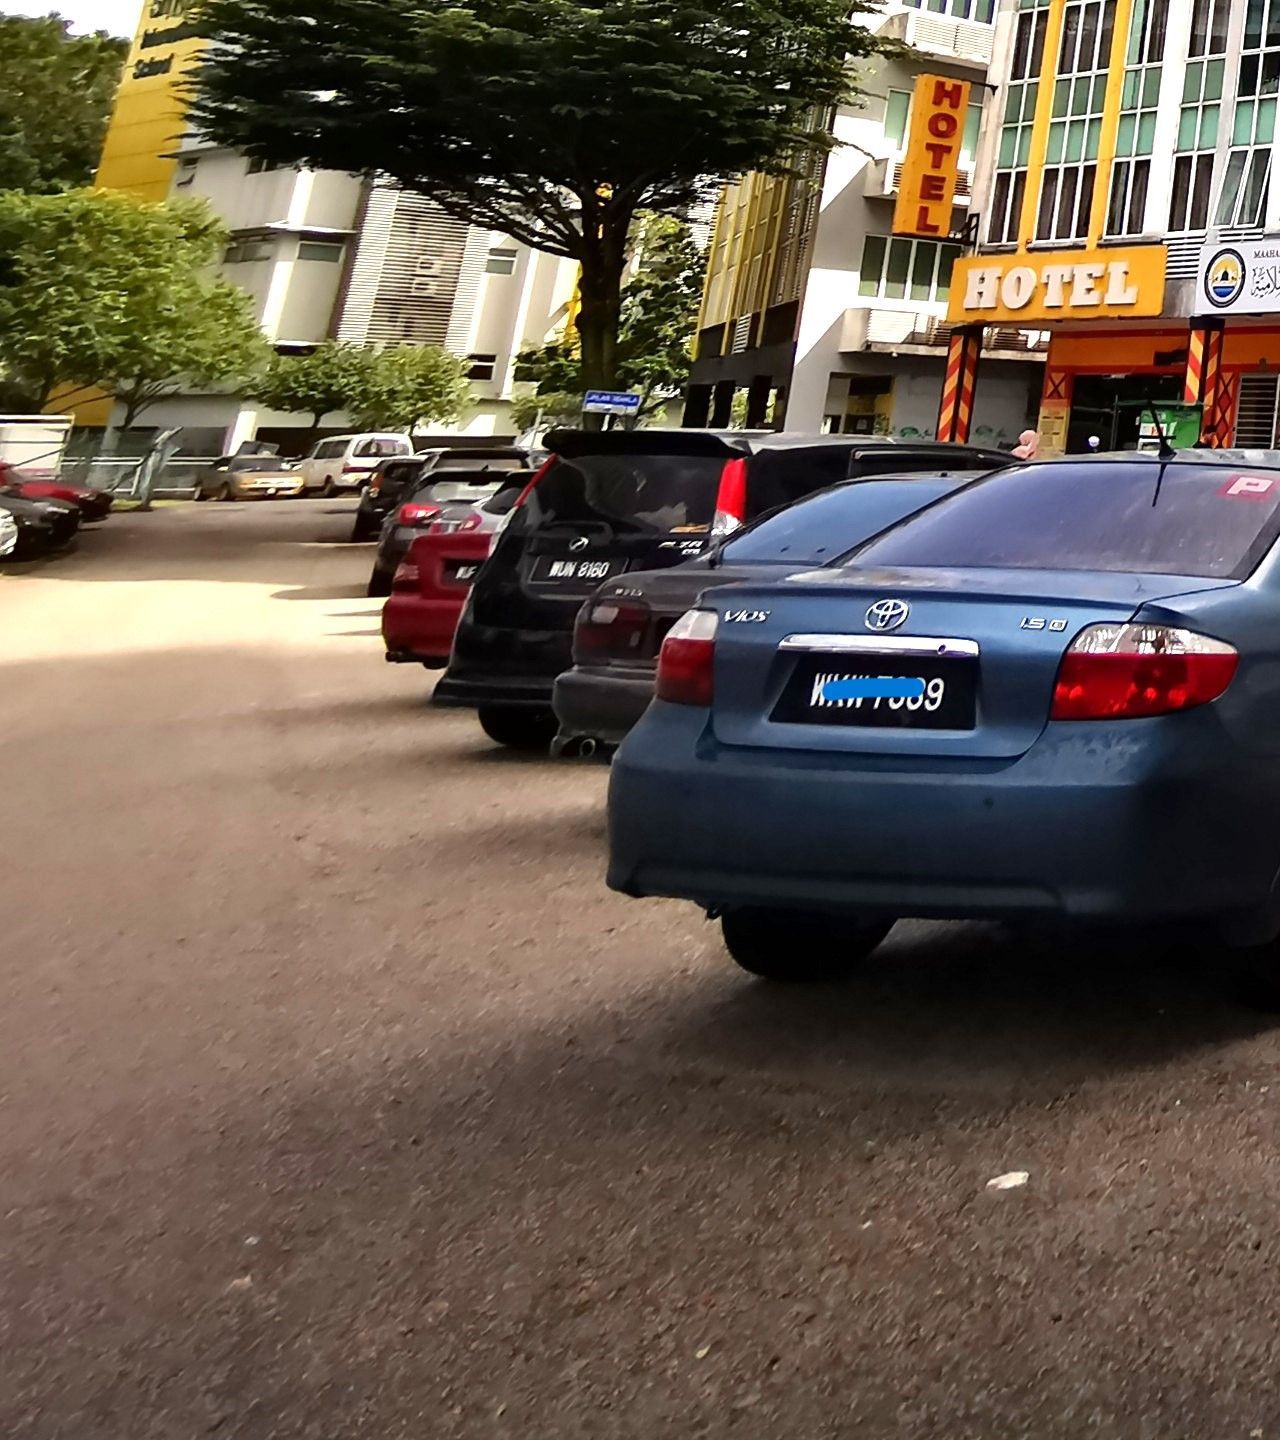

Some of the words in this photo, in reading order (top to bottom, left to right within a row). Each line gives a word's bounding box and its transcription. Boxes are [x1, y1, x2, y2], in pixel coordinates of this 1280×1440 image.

[916, 80, 962, 233] HOTEL
[963, 261, 1138, 310] HOTEL
[1227, 477, 1272, 495] P
